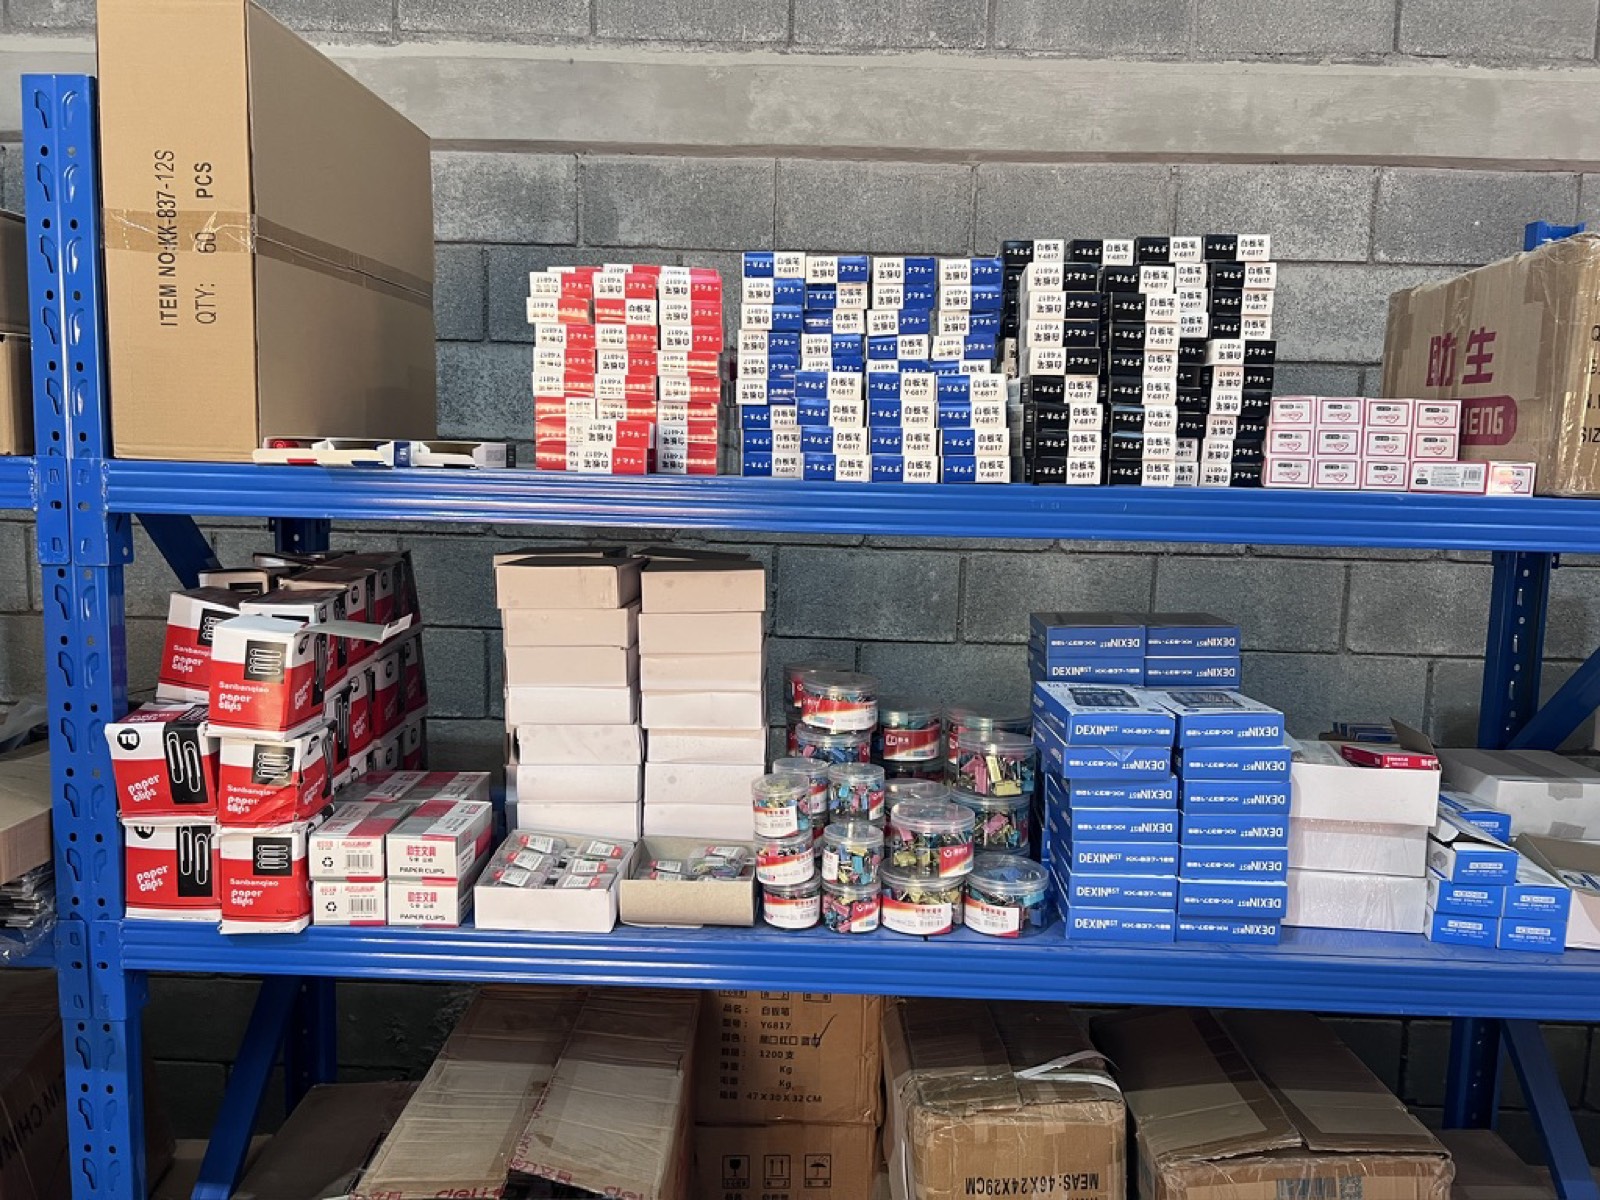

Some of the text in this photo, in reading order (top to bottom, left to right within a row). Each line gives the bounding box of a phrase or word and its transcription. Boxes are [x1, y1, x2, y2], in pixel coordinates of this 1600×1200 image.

[194, 161, 214, 199] PCS
[159, 283, 179, 327] ITEM
[195, 283, 217, 325] QTY:
[220, 693, 252, 706] paper
[219, 701, 242, 712] clips
[128, 775, 159, 796] paper
[133, 788, 156, 801] clips
[228, 796, 260, 808] paper
[227, 803, 250, 814] clips
[136, 865, 168, 884] paper
[399, 866, 425, 874] PAPER
[140, 878, 163, 891] clips
[231, 889, 263, 901] paper
[231, 897, 253, 907] clips
[399, 913, 425, 921] PAPER
[761, 1021, 791, 1030] Y6817
